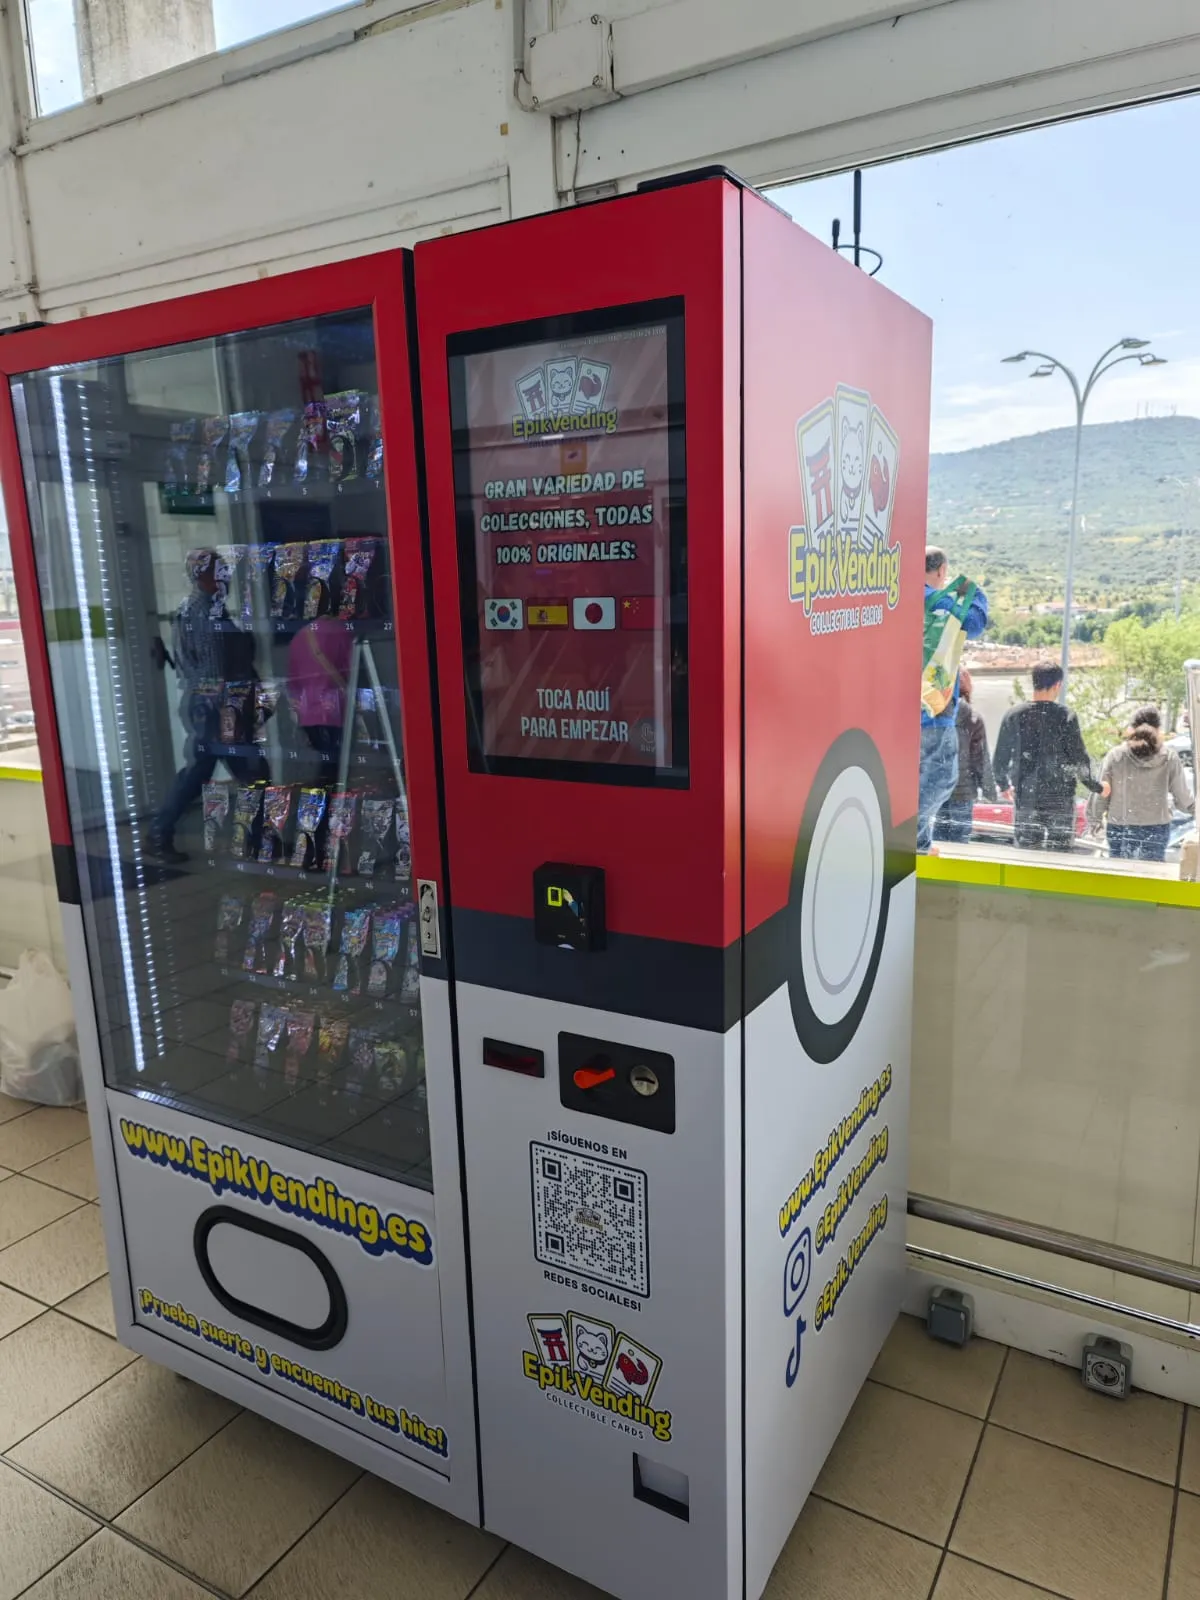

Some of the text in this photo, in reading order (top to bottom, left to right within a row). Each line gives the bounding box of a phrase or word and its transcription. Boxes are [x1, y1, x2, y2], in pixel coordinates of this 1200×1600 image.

[512, 407, 617, 439] EpikVending
[484, 469, 645, 499] GRAN VARIEDAD DE
[480, 504, 653, 533] COLECCIONES, TODAS
[496, 542, 637, 564] 100% ORIGINALES:
[788, 525, 900, 616] EpikVending
[383, 622, 393, 631] 27
[810, 605, 883, 635] COLLECTIBLE CARDS
[536, 686, 611, 713] TOCA AQUÍ
[520, 716, 629, 743] PARA EMPEZAR
[547, 1129, 628, 1160] ¡SÍGUENOS EN
[779, 1064, 892, 1238] www.EpikVending.es
[120, 1118, 433, 1266] www.EpikVending.es
[814, 1126, 889, 1254] @EpikVending
[543, 1270, 578, 1292] REDES
[581, 1282, 641, 1312] SOCIALES!
[139, 1288, 448, 1458] ¡Prueba suerte y encuentra tus hits!
[522, 1350, 672, 1442] EpikVending
[545, 1392, 645, 1440] COLLECTIBLE CARDS
